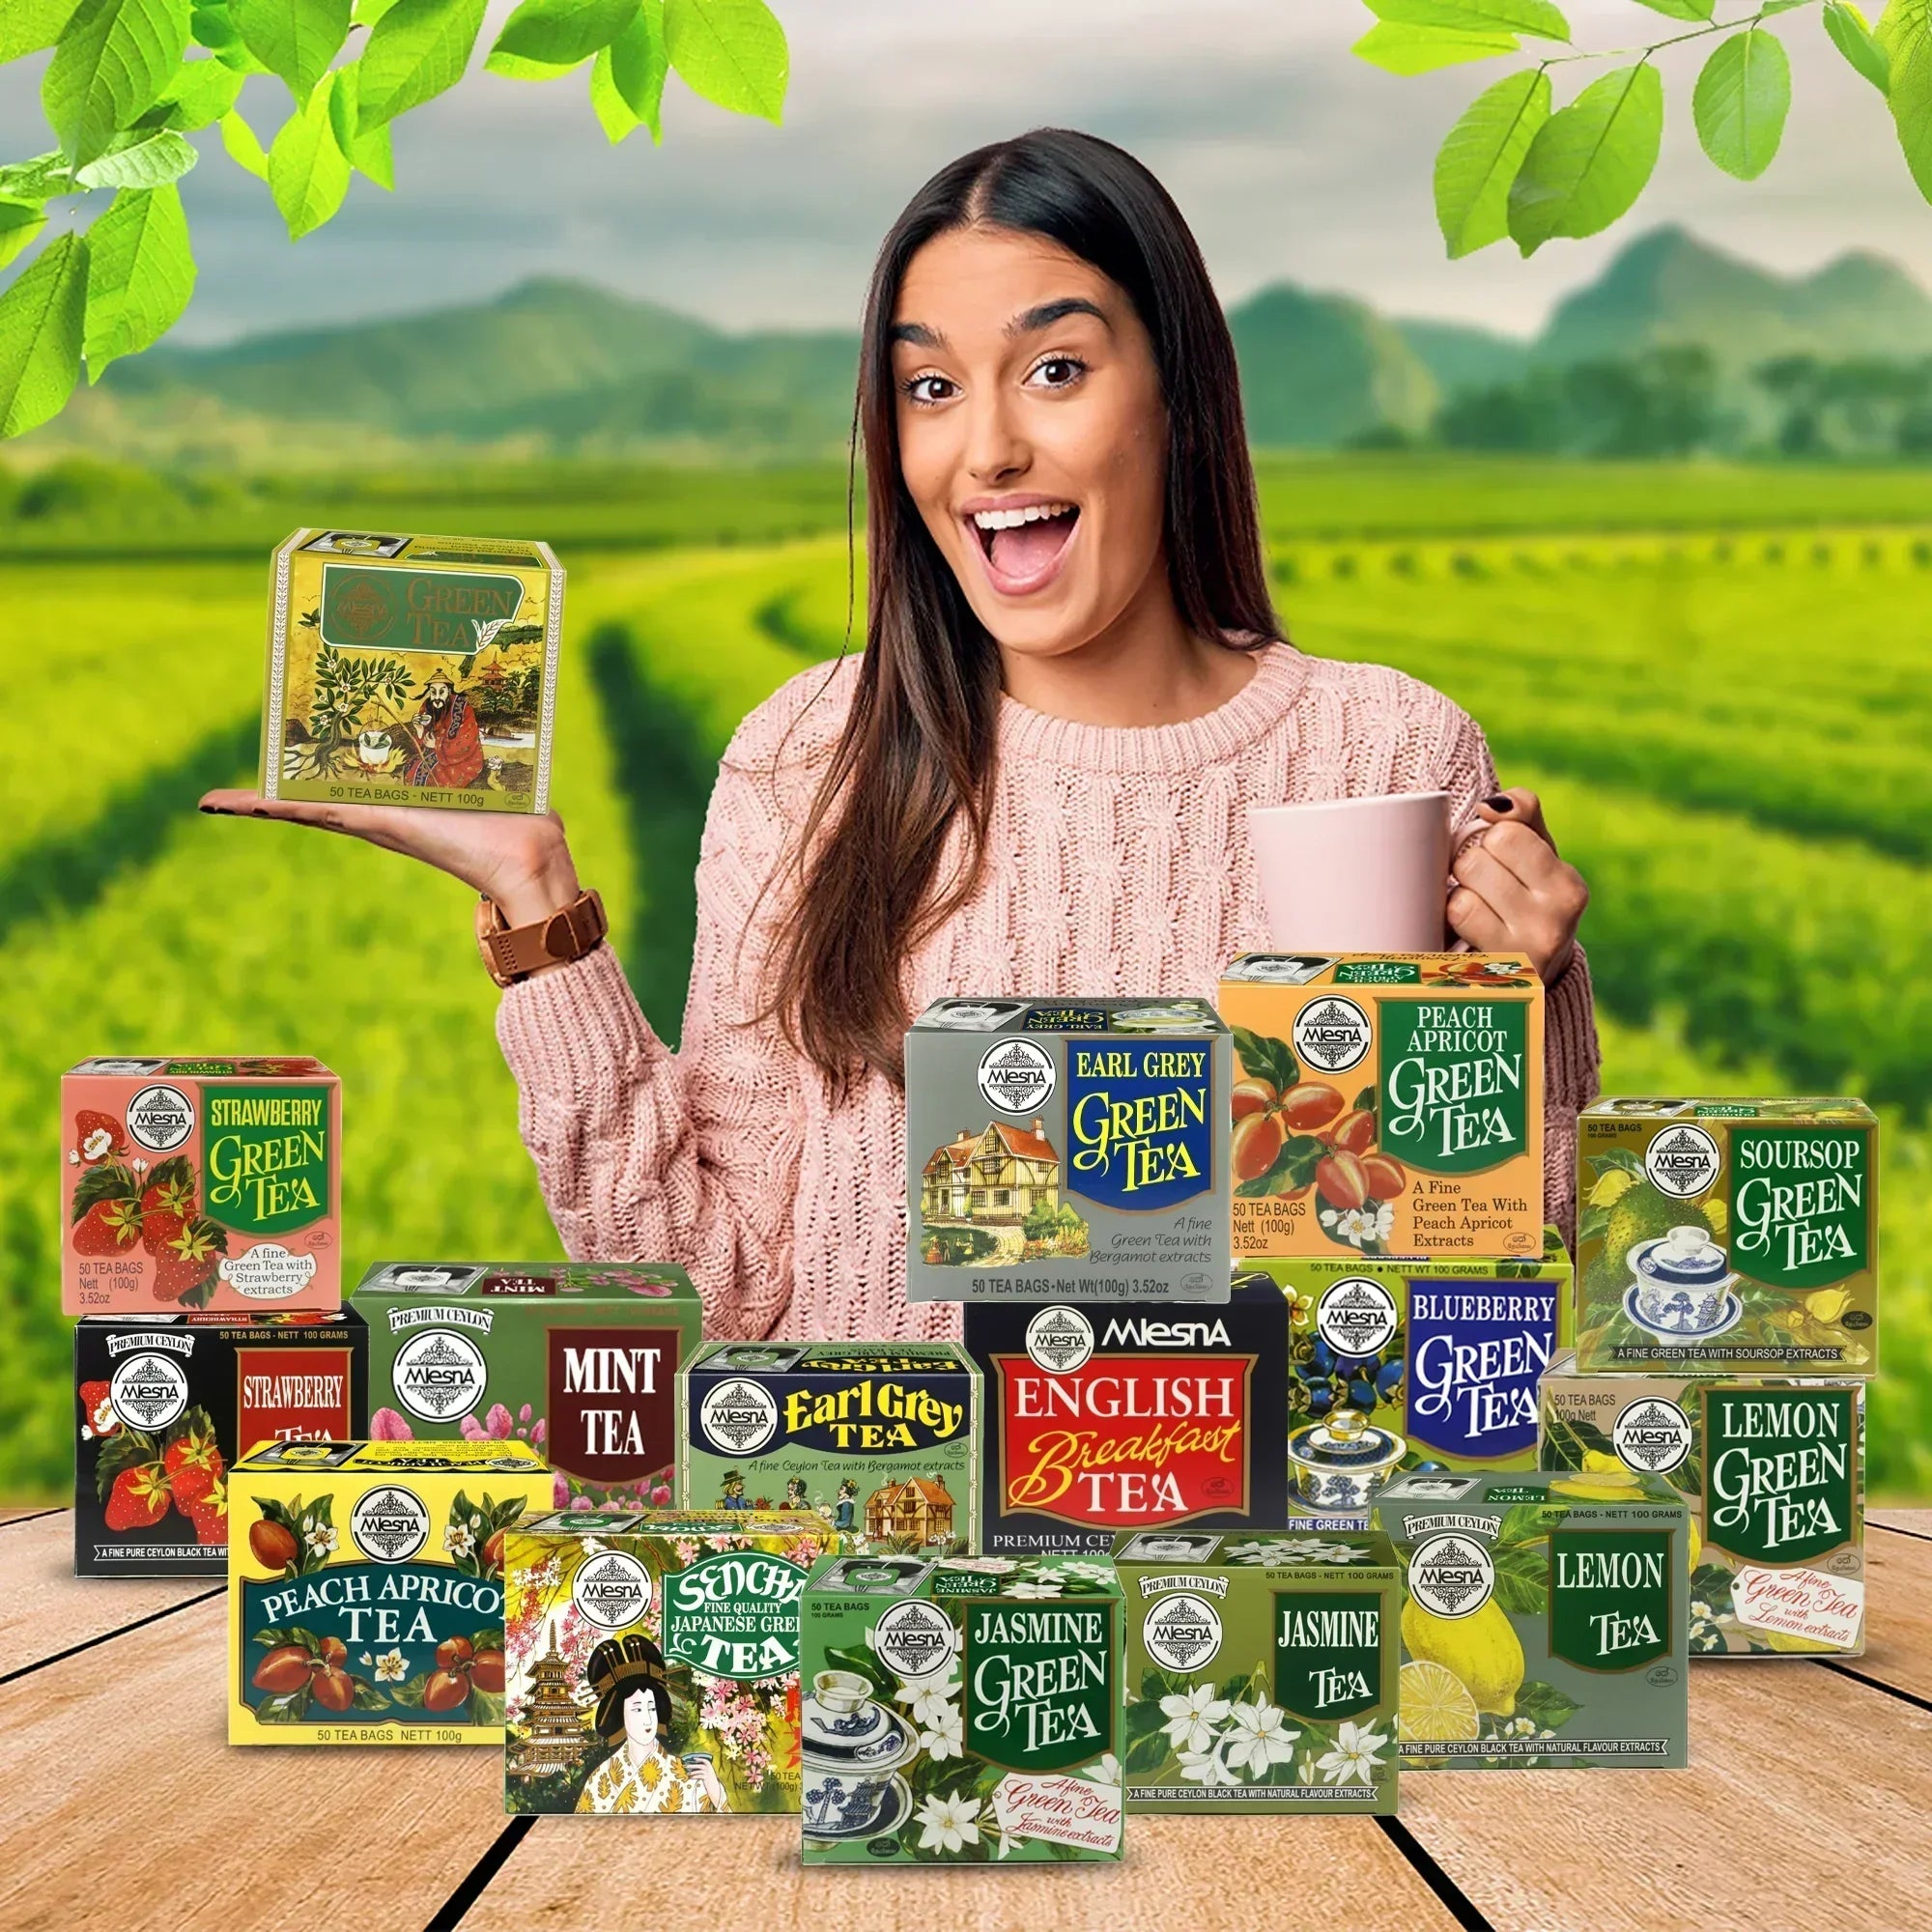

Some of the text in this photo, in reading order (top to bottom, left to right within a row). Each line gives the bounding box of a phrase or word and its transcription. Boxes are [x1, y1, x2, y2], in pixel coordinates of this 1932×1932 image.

[408, 578, 514, 615] GREEN
[408, 611, 470, 648] TEA
[330, 787, 484, 806] 50 TEA BAGS NETT 100g
[1417, 1007, 1492, 1029] PEACH
[1406, 1031, 1507, 1053] APRICOT
[1076, 1052, 1206, 1078] EARL GREY
[1388, 1052, 1521, 1142] GREEN
[212, 1099, 322, 1126] STRAWBERRY
[1073, 1087, 1206, 1177] GREEN
[1430, 1101, 1517, 1157] TEA
[1114, 1138, 1201, 1192] TEA
[1740, 1139, 1860, 1170] SOURSOP
[210, 1130, 325, 1209] GREEN
[245, 1174, 321, 1221] TEA
[1413, 1181, 1461, 1194] A Fine
[1413, 1199, 1528, 1211] Green Tea With
[1737, 1173, 1862, 1257] GREEN
[1175, 1217, 1212, 1233] A fine
[1413, 1216, 1513, 1232] Peach Apricot
[251, 1248, 286, 1258] A fine
[1111, 1234, 1211, 1248] Green Tea with
[1413, 1235, 1474, 1247] Extracts
[1776, 1220, 1857, 1271] TEA
[79, 1262, 143, 1273] 50 TEA BAGS
[224, 1262, 261, 1272] Green
[286, 1260, 312, 1269] with
[1090, 1250, 1211, 1265] Bergamot extracts
[79, 1277, 138, 1291] Nett (100g)
[236, 1272, 302, 1285] Strawberry
[243, 1285, 293, 1294] extracts
[79, 1293, 110, 1304] 3.52oz
[1413, 1294, 1555, 1322] BLUEBERRY
[391, 1310, 491, 1329] PREMIUM CEYLON
[110, 1335, 193, 1352] PREMIUM CEYLON
[249, 1331, 270, 1340] BAGS
[1617, 1349, 1837, 1359] A FINE GREEN TEA WITH SOURSOP EXTRACTS
[563, 1348, 661, 1394] MINT
[1415, 1330, 1552, 1423] GREEN
[243, 1376, 343, 1408] STRAWBERRY
[1014, 1377, 1235, 1418] ENGLISH
[783, 1379, 963, 1438] Earl Grey
[1722, 1403, 1839, 1438] LEMON
[581, 1409, 645, 1456] TEA
[830, 1424, 918, 1448] TEA
[749, 1461, 965, 1473] A fine Ceylon Tea with Bergamot extracts
[1009, 1420, 1240, 1508] Breakfast
[1077, 1471, 1188, 1513] TEA
[1713, 1442, 1847, 1534] GREEN
[1406, 1517, 1498, 1535] PREMIUM CEYLON
[1754, 1494, 1841, 1548] TEA
[127, 1548, 145, 1557] PURE
[147, 1548, 176, 1557] CEYLON
[178, 1548, 201, 1557] BLACK
[203, 1548, 218, 1557] TEA
[993, 1534, 1080, 1548] PREMIUM
[1557, 1551, 1664, 1589] LEMON
[262, 1574, 504, 1623] PEACH APRICO
[1142, 1577, 1227, 1594] PREMIUM CEYLON
[704, 1603, 781, 1614] FINE QUALITY
[811, 1603, 869, 1611] 50 TEA BAGS
[338, 1606, 437, 1642] TEA
[671, 1616, 800, 1632] JAPANESE GRE
[975, 1612, 1102, 1644] JASMINE
[1278, 1610, 1378, 1648] JASMINE
[1590, 1611, 1662, 1656] TEA
[699, 1634, 796, 1673] TEA
[974, 1648, 1107, 1738] GREEN
[1309, 1666, 1373, 1709] TEA
[318, 1730, 462, 1743] 50 TEA BAGS NETT 100g
[1014, 1699, 1100, 1752] TEA
[1005, 1779, 1120, 1825] Green Tea
[1065, 1781, 1094, 1798] fine
[1007, 1812, 1114, 1847] Jasmine extracts
[1047, 1817, 1072, 1828] with
